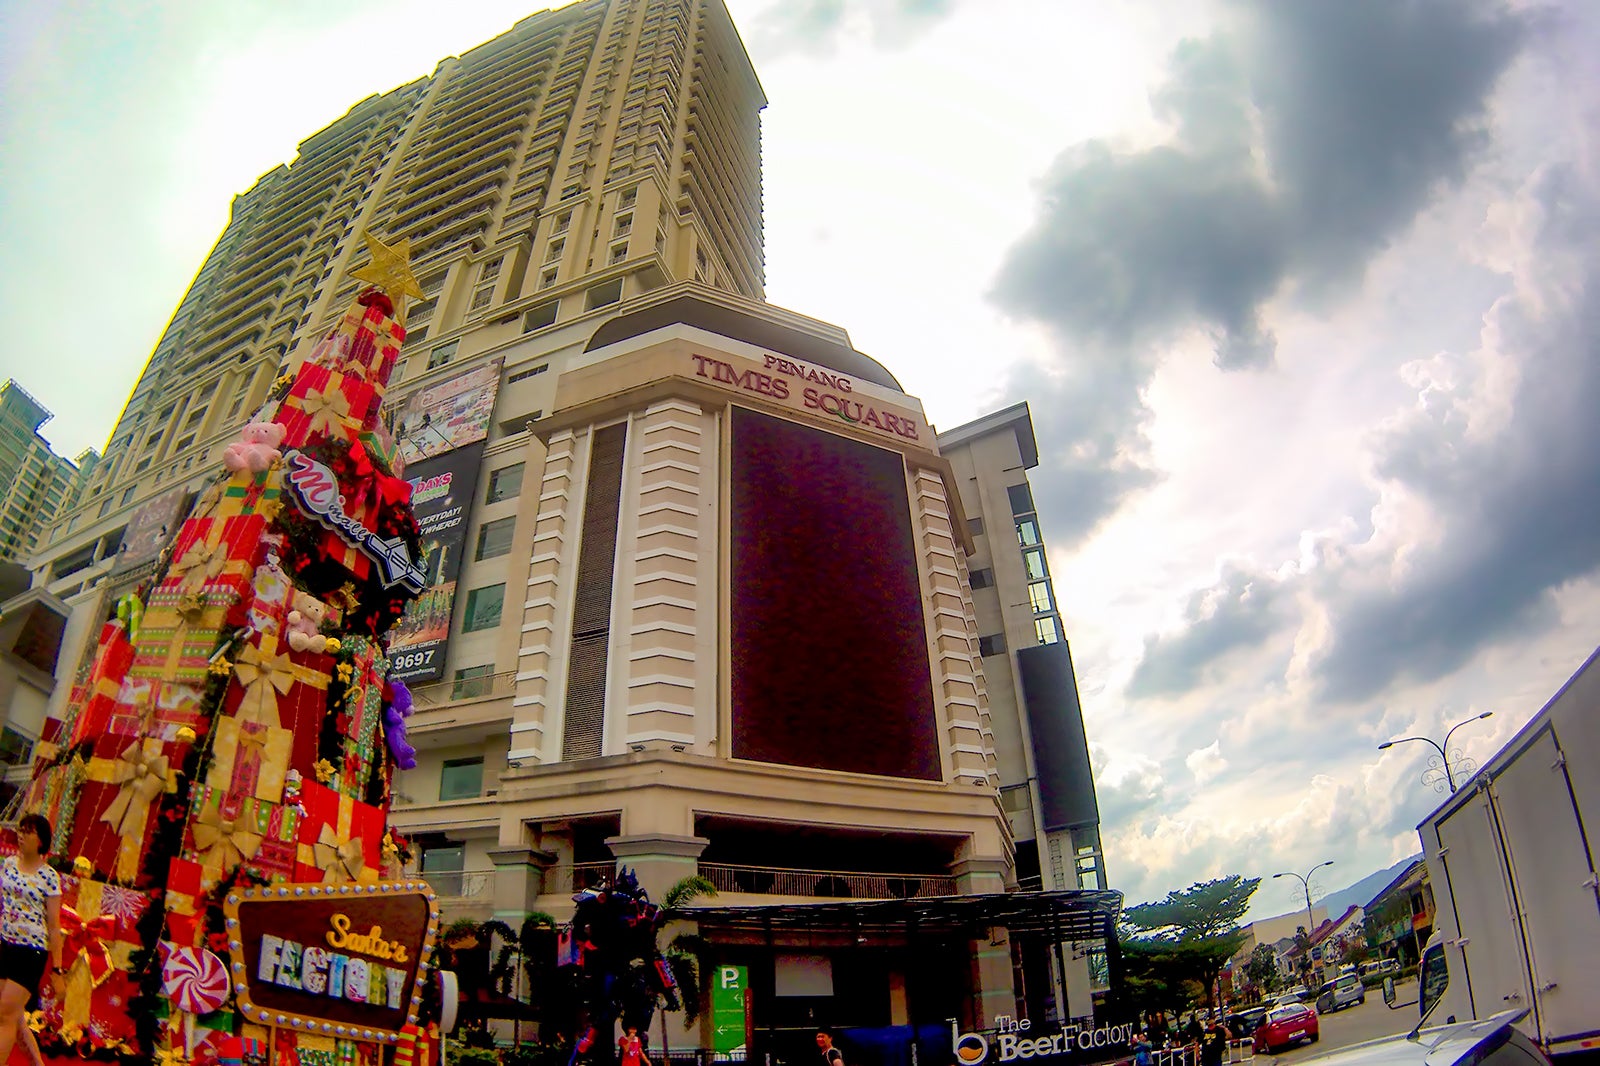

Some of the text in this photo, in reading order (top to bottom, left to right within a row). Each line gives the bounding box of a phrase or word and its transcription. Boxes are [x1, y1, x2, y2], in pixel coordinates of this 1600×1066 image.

[763, 354, 852, 393] PENANG
[692, 353, 919, 440] TIMES SQUARE
[420, 517, 462, 535] YWHERE!
[395, 650, 435, 670] 9697
[325, 913, 408, 963] Santa's
[257, 933, 408, 1009] FACTORY
[721, 967, 739, 989] P
[995, 1014, 1031, 1033] The
